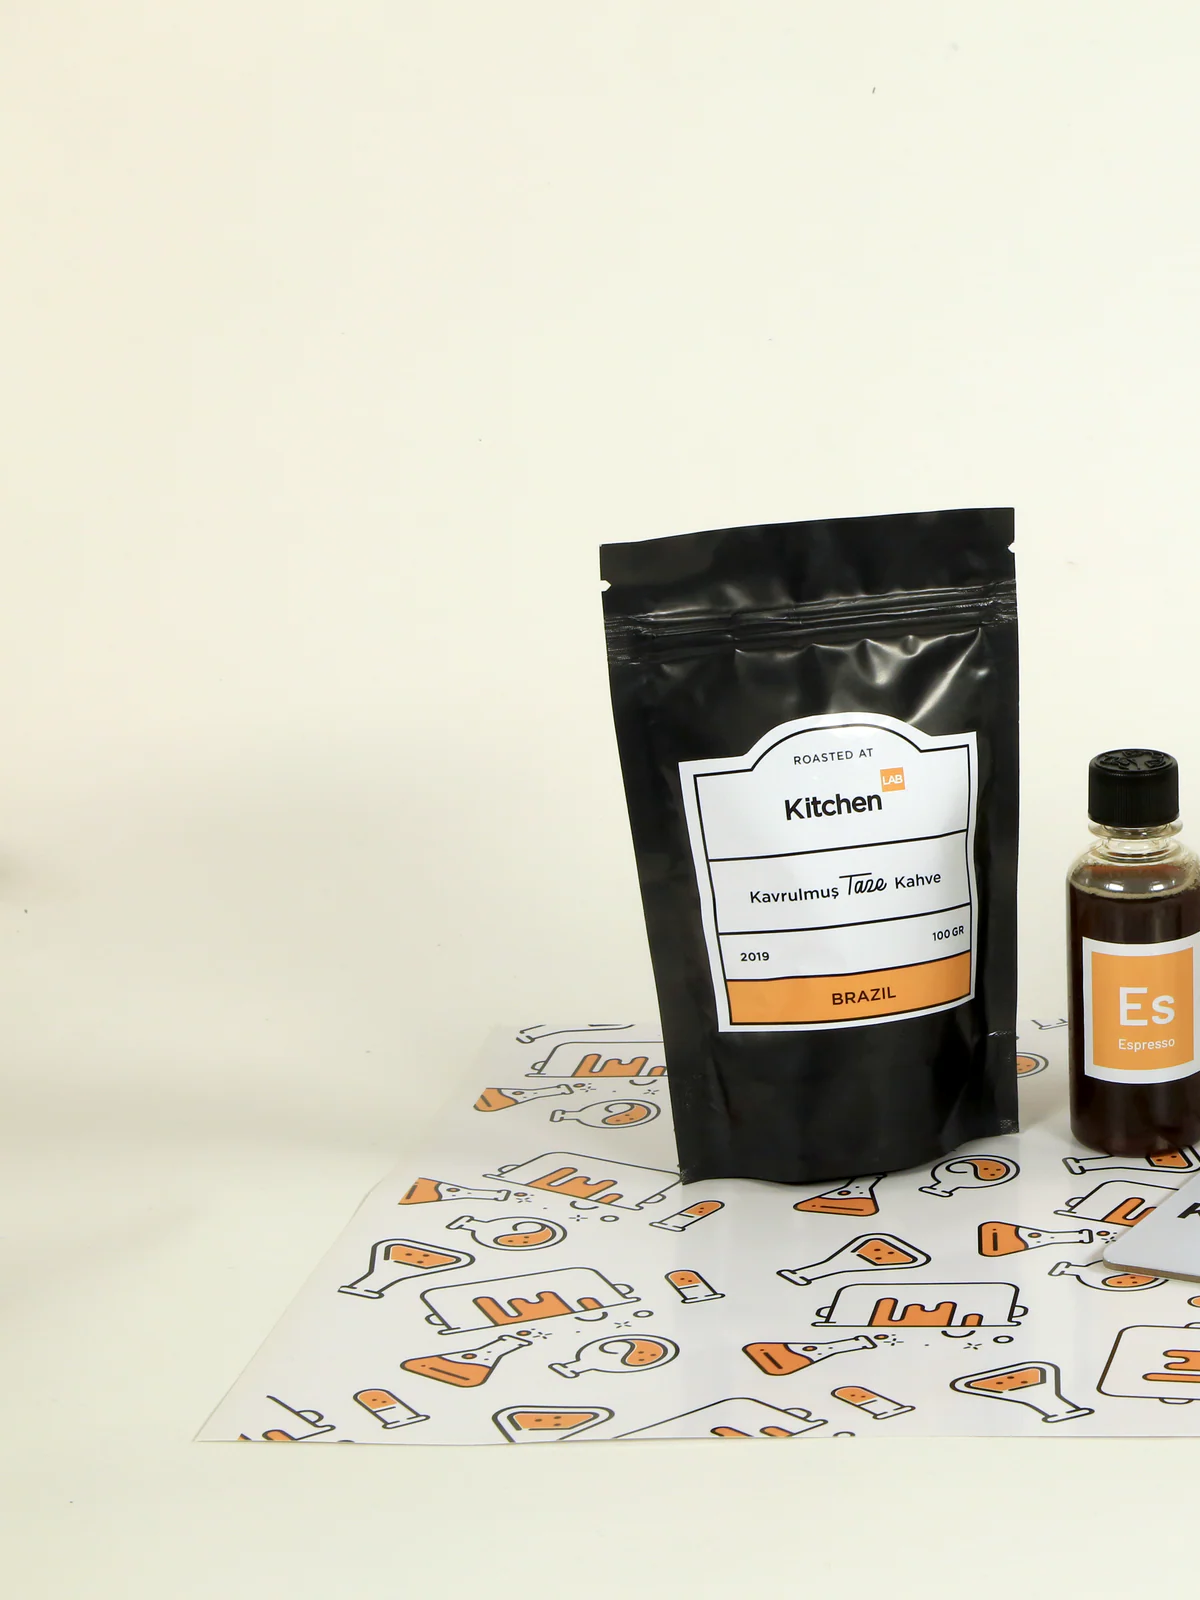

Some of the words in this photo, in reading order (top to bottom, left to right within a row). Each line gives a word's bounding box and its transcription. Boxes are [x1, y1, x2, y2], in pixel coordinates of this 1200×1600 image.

[793, 750, 854, 764] ROASTED
[859, 748, 873, 759] AT
[882, 774, 903, 786] LAB
[784, 793, 883, 820] Kitchen
[750, 886, 839, 904] Kavrulmuş
[894, 873, 942, 889] Kahve
[932, 929, 951, 941] 100
[951, 925, 965, 937] GR
[740, 951, 770, 962] 2019
[831, 986, 897, 1006] BRAZIL
[1119, 986, 1175, 1026] Es
[1118, 1038, 1175, 1053] Espresso
